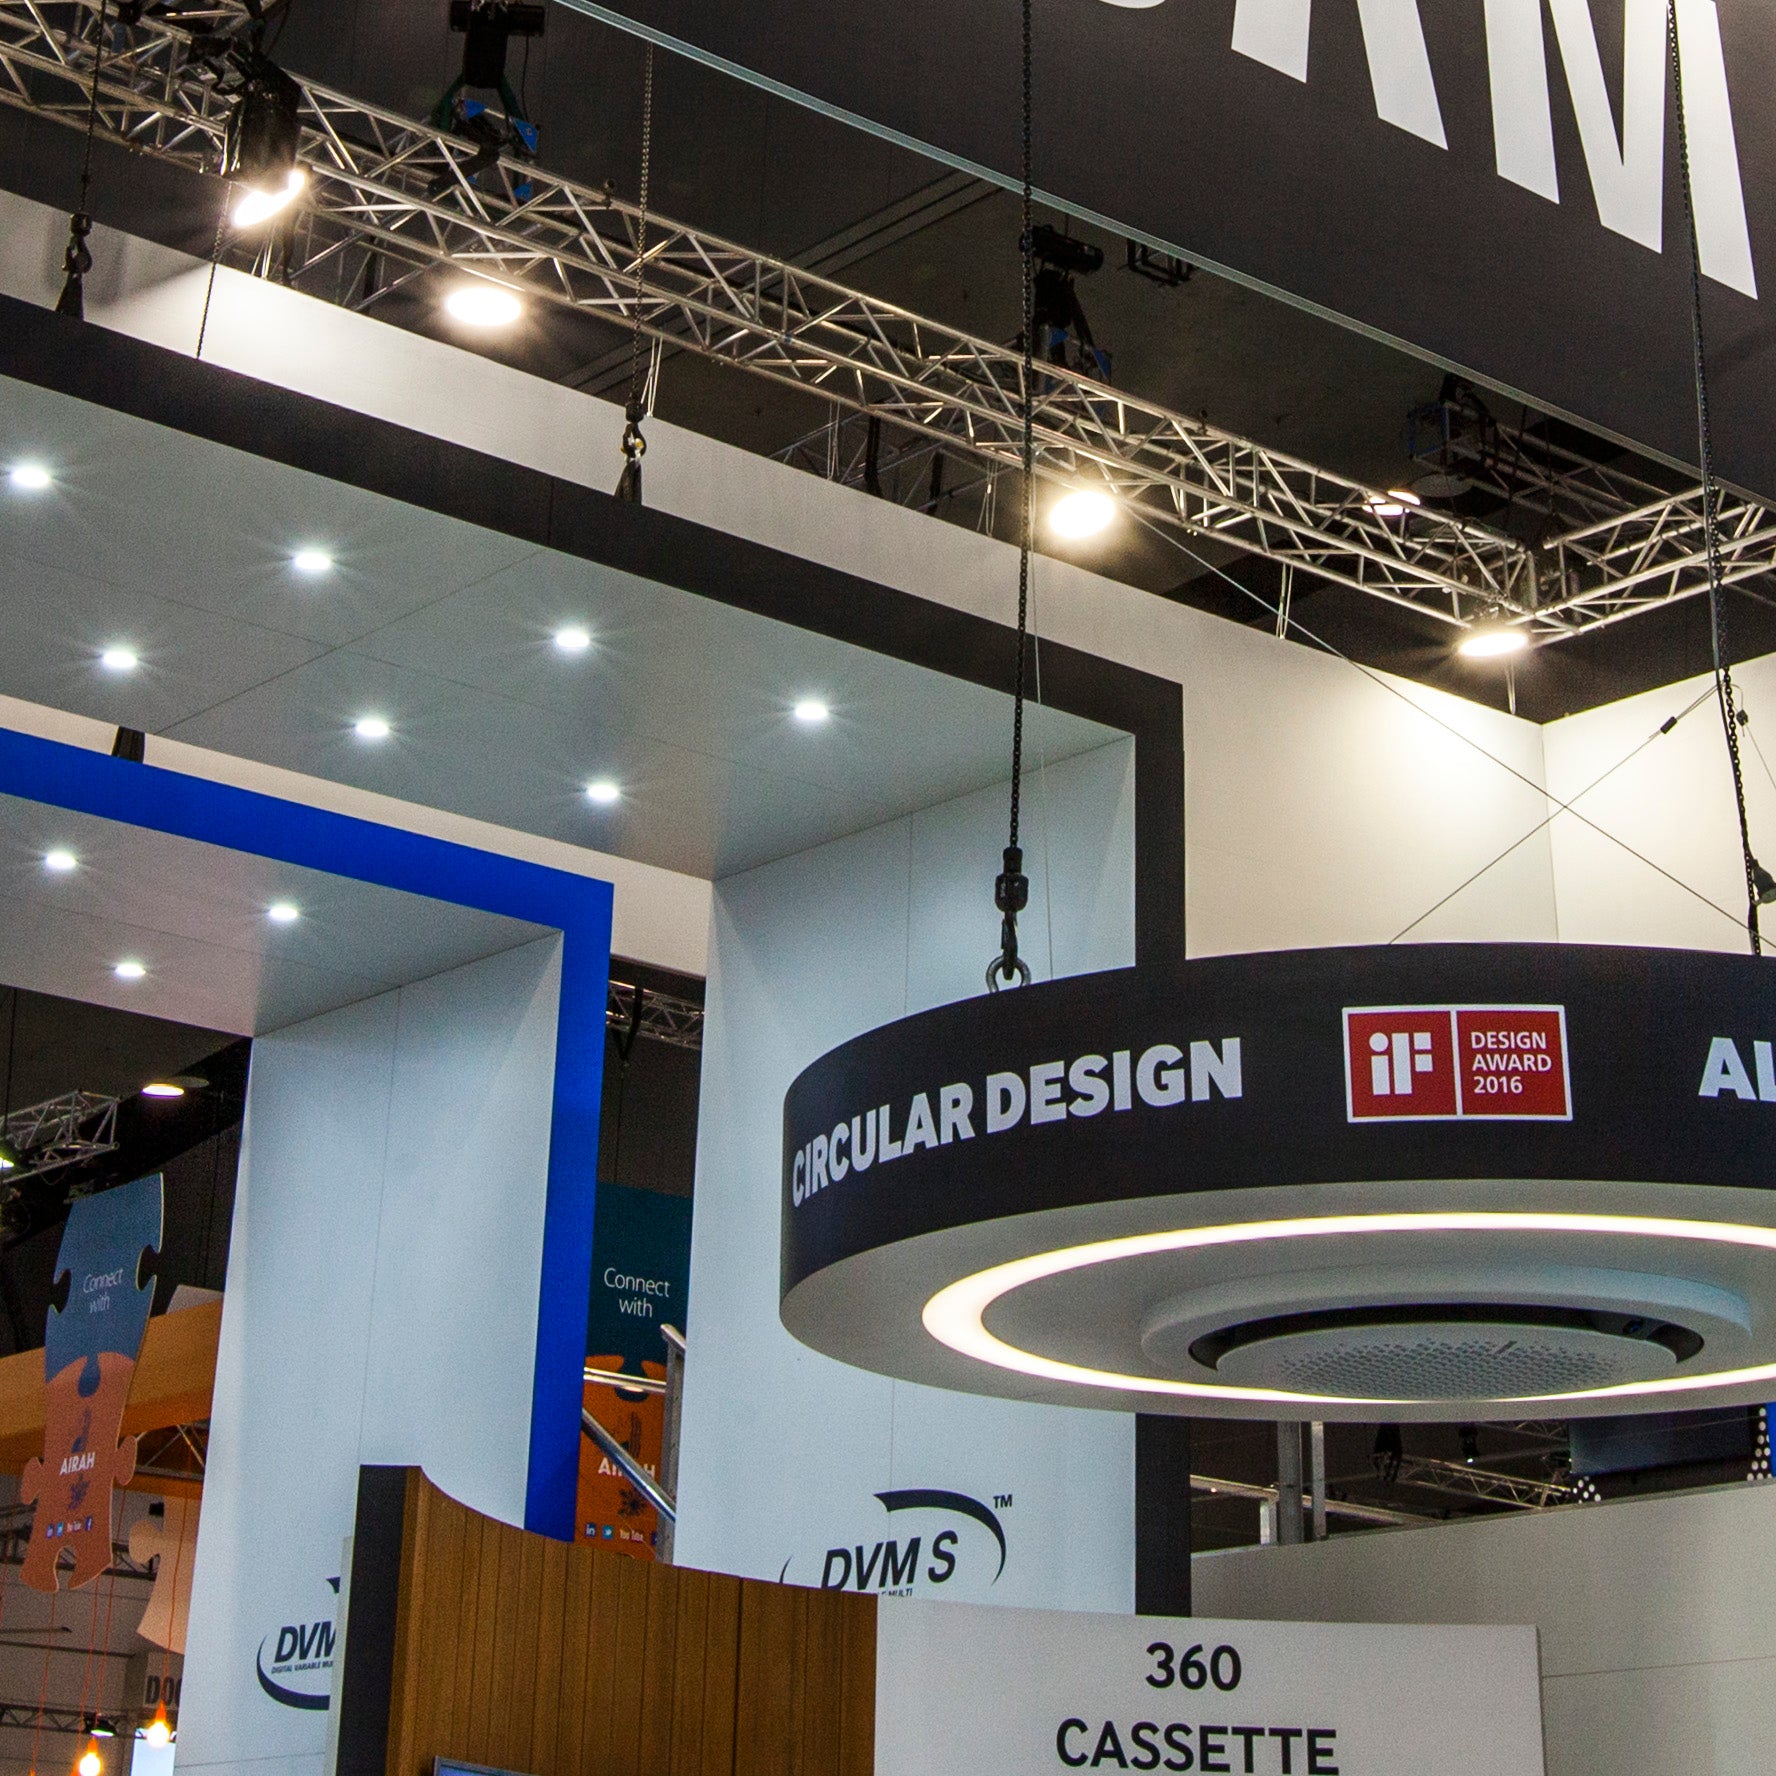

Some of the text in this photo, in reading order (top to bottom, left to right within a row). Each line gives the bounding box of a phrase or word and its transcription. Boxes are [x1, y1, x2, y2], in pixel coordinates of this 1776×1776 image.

[1471, 1031, 1546, 1049] DESIGN
[1472, 1054, 1552, 1071] AWARD
[1473, 1076, 1523, 1094] 2016
[792, 1037, 1243, 1208] CIRCULAR DESIGN
[83, 1268, 124, 1293] Connect
[604, 1267, 671, 1297] Connect
[89, 1293, 110, 1314] with
[619, 1297, 653, 1318] with
[60, 1452, 96, 1475] AIRAH
[821, 1537, 921, 1592] DVM
[1145, 1641, 1242, 1692] 360
[1056, 1718, 1340, 1776] CASSETTE
